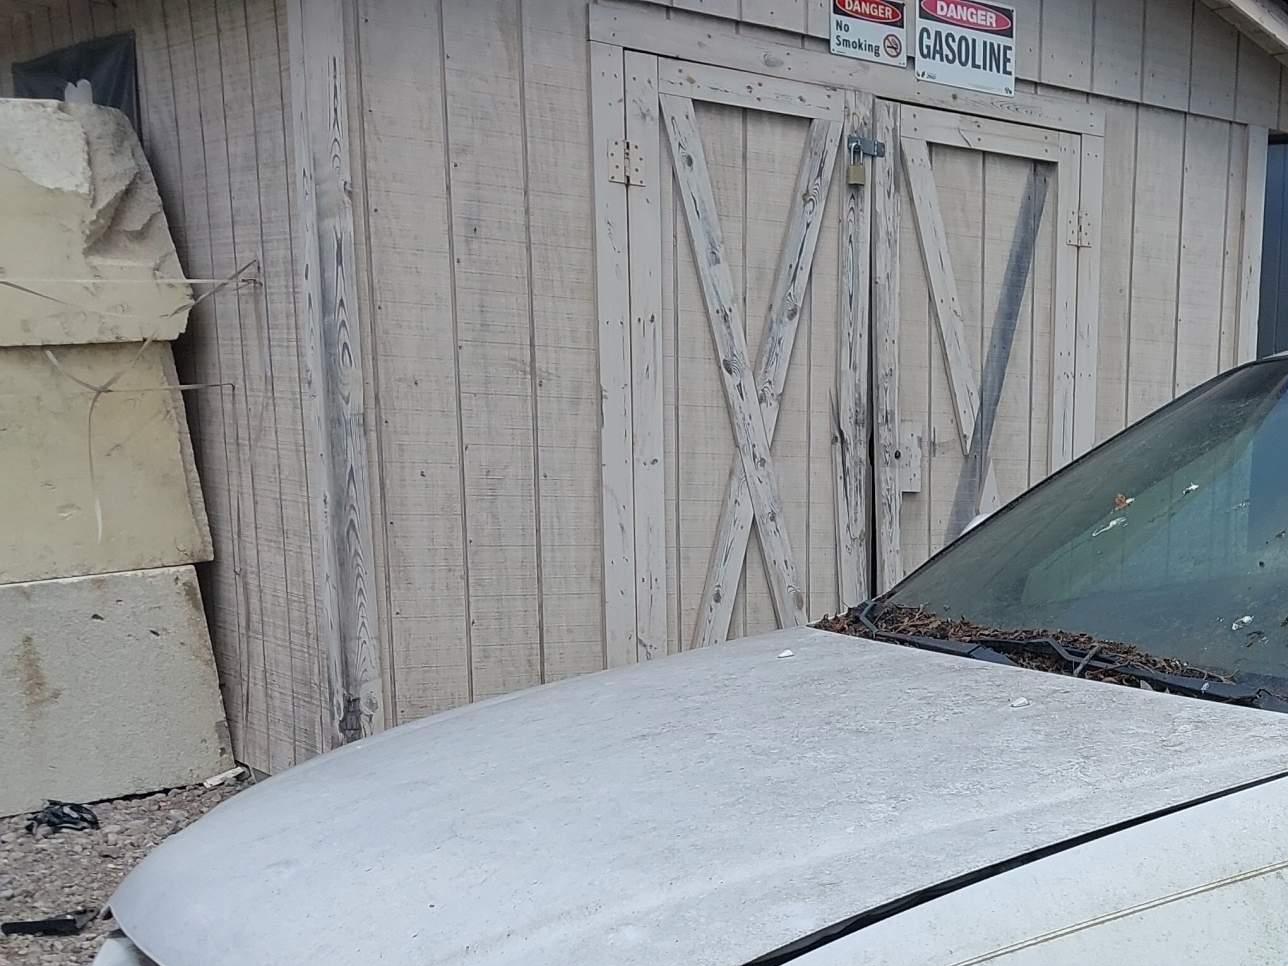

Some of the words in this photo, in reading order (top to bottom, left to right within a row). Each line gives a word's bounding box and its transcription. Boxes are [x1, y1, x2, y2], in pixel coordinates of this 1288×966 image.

[845, 0, 893, 19] DANGER
[936, 0, 997, 28] DANGER
[836, 20, 850, 33] No
[836, 35, 881, 57] Smoking
[919, 26, 1013, 77] GASOLINE
